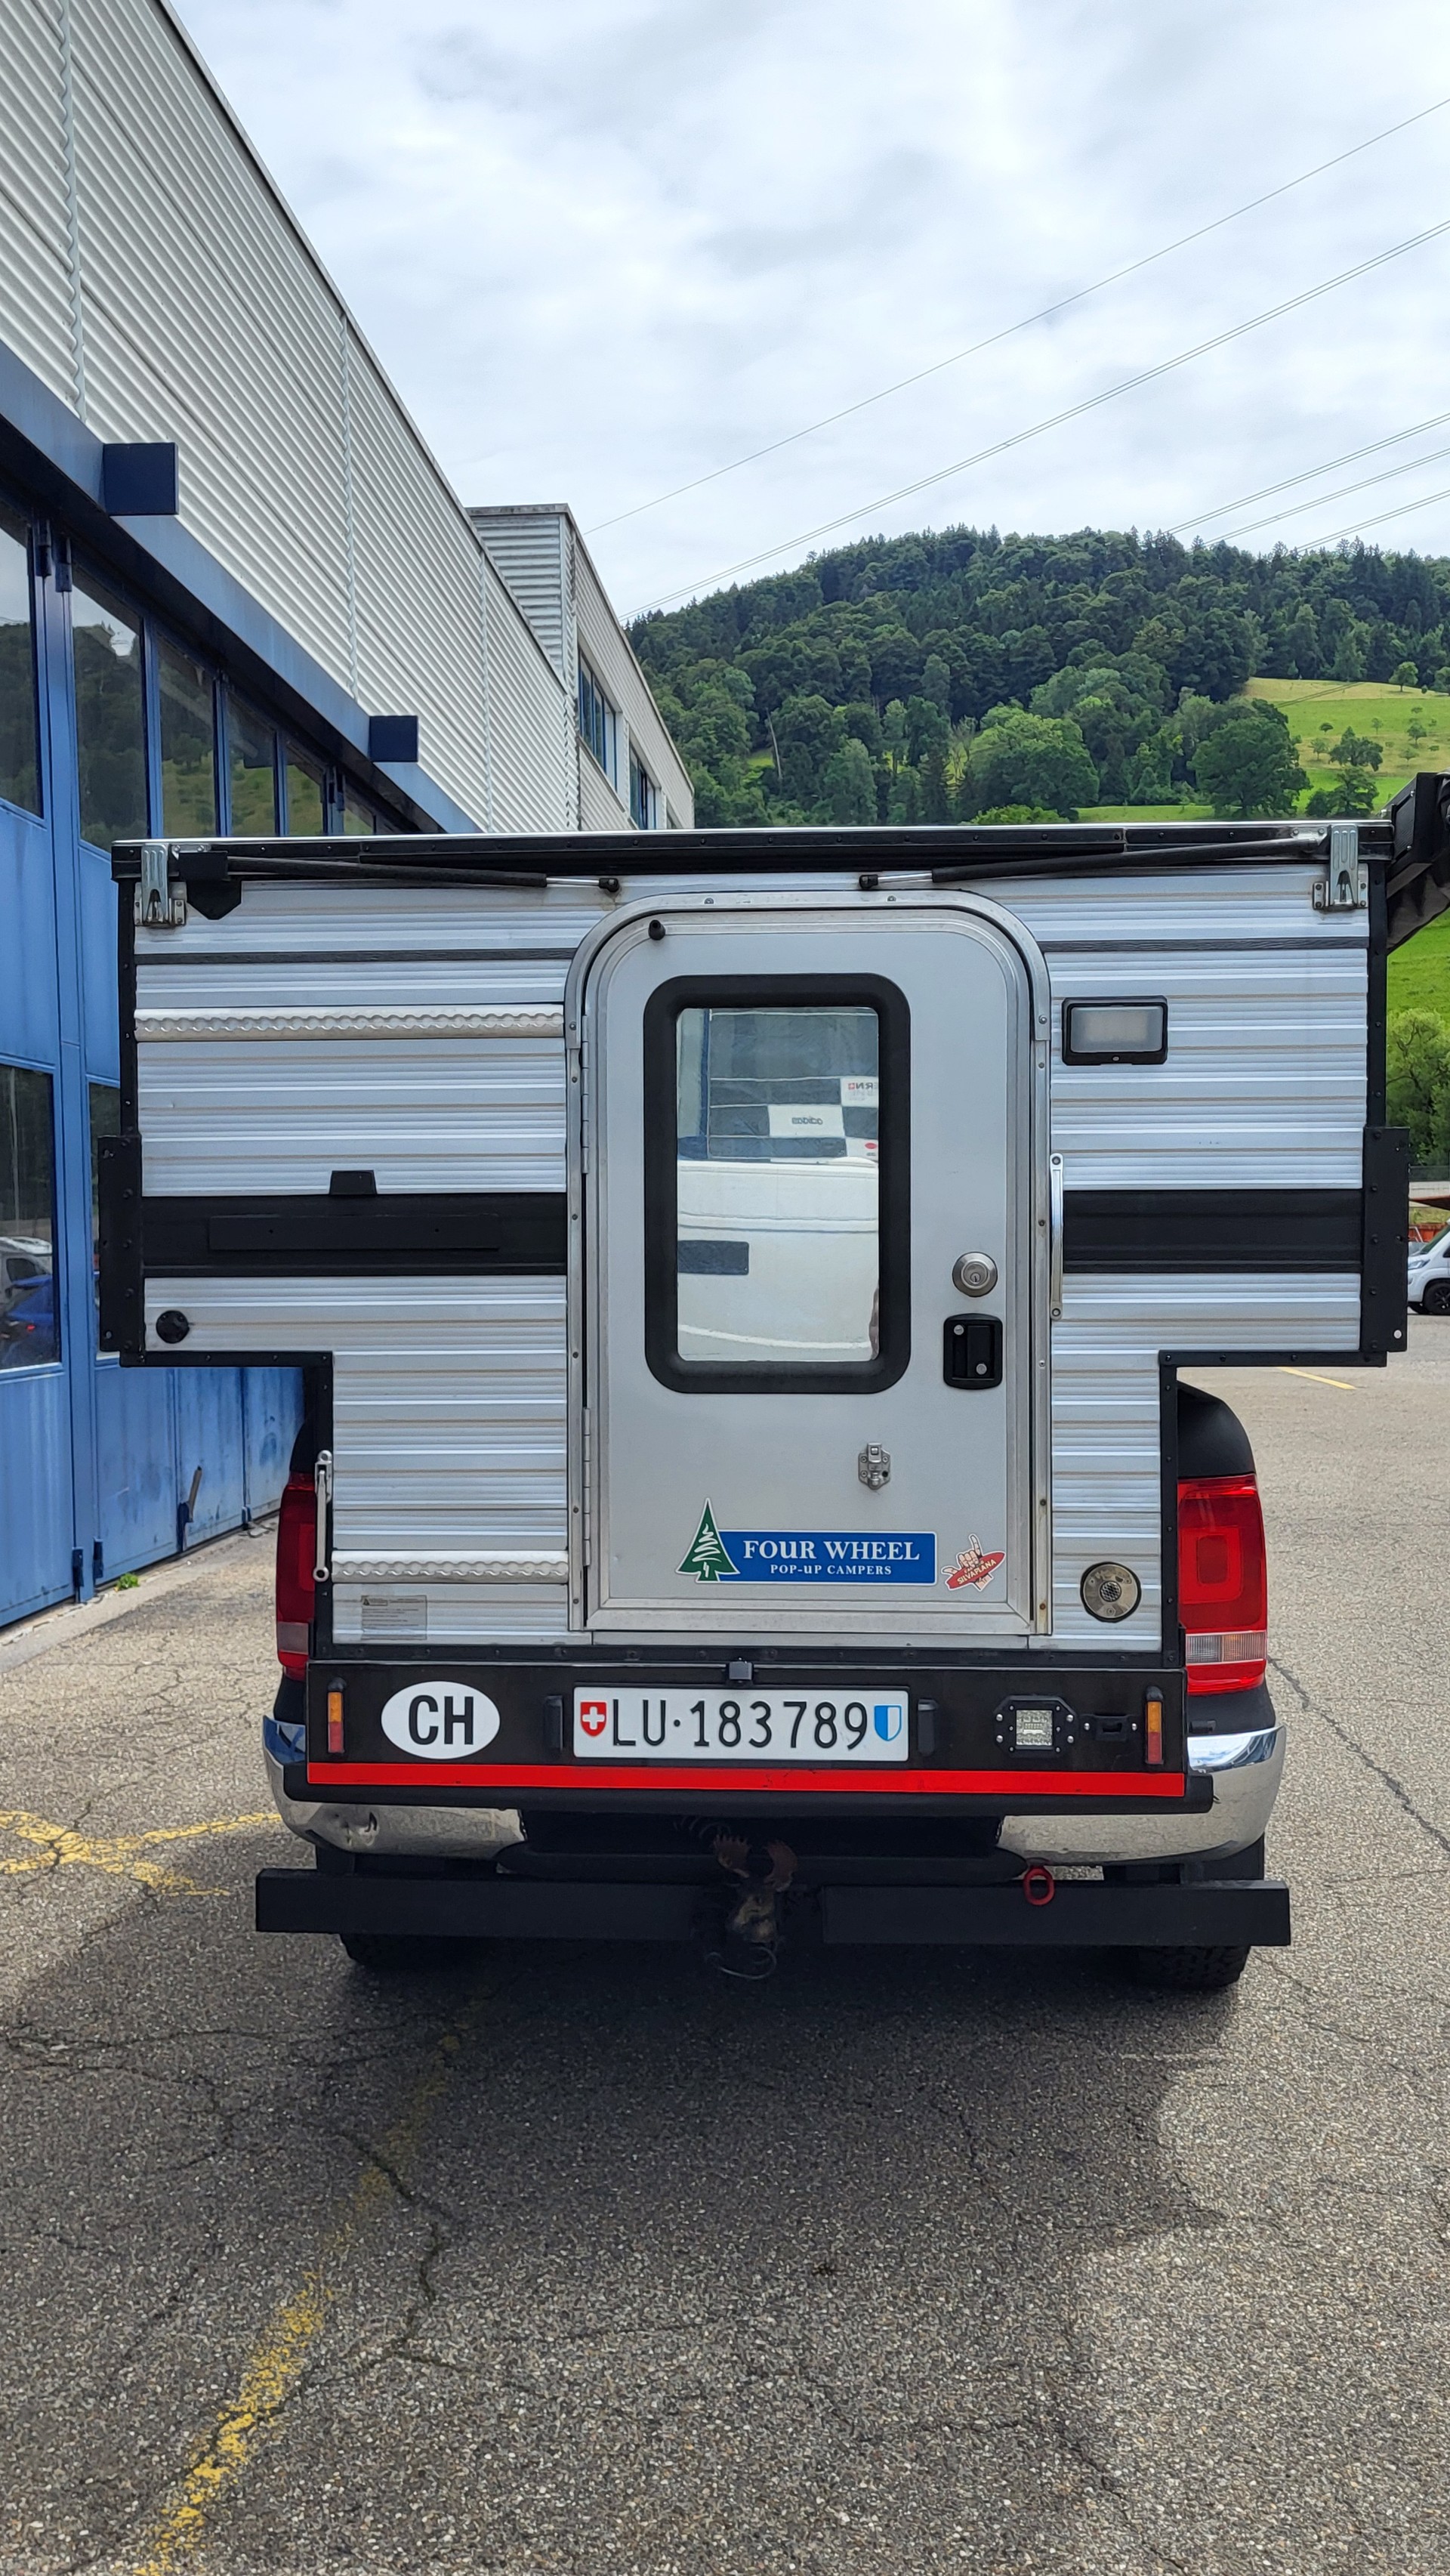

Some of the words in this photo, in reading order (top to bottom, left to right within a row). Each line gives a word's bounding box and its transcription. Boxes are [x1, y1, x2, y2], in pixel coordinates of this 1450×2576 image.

[743, 1540, 817, 1559] FOUR
[823, 1541, 921, 1561] WHEEL
[770, 1564, 822, 1574] POP-UP
[827, 1564, 892, 1575] CAMPERS
[957, 1558, 997, 1585] SILVAPLANA
[408, 1694, 474, 1746] CH
